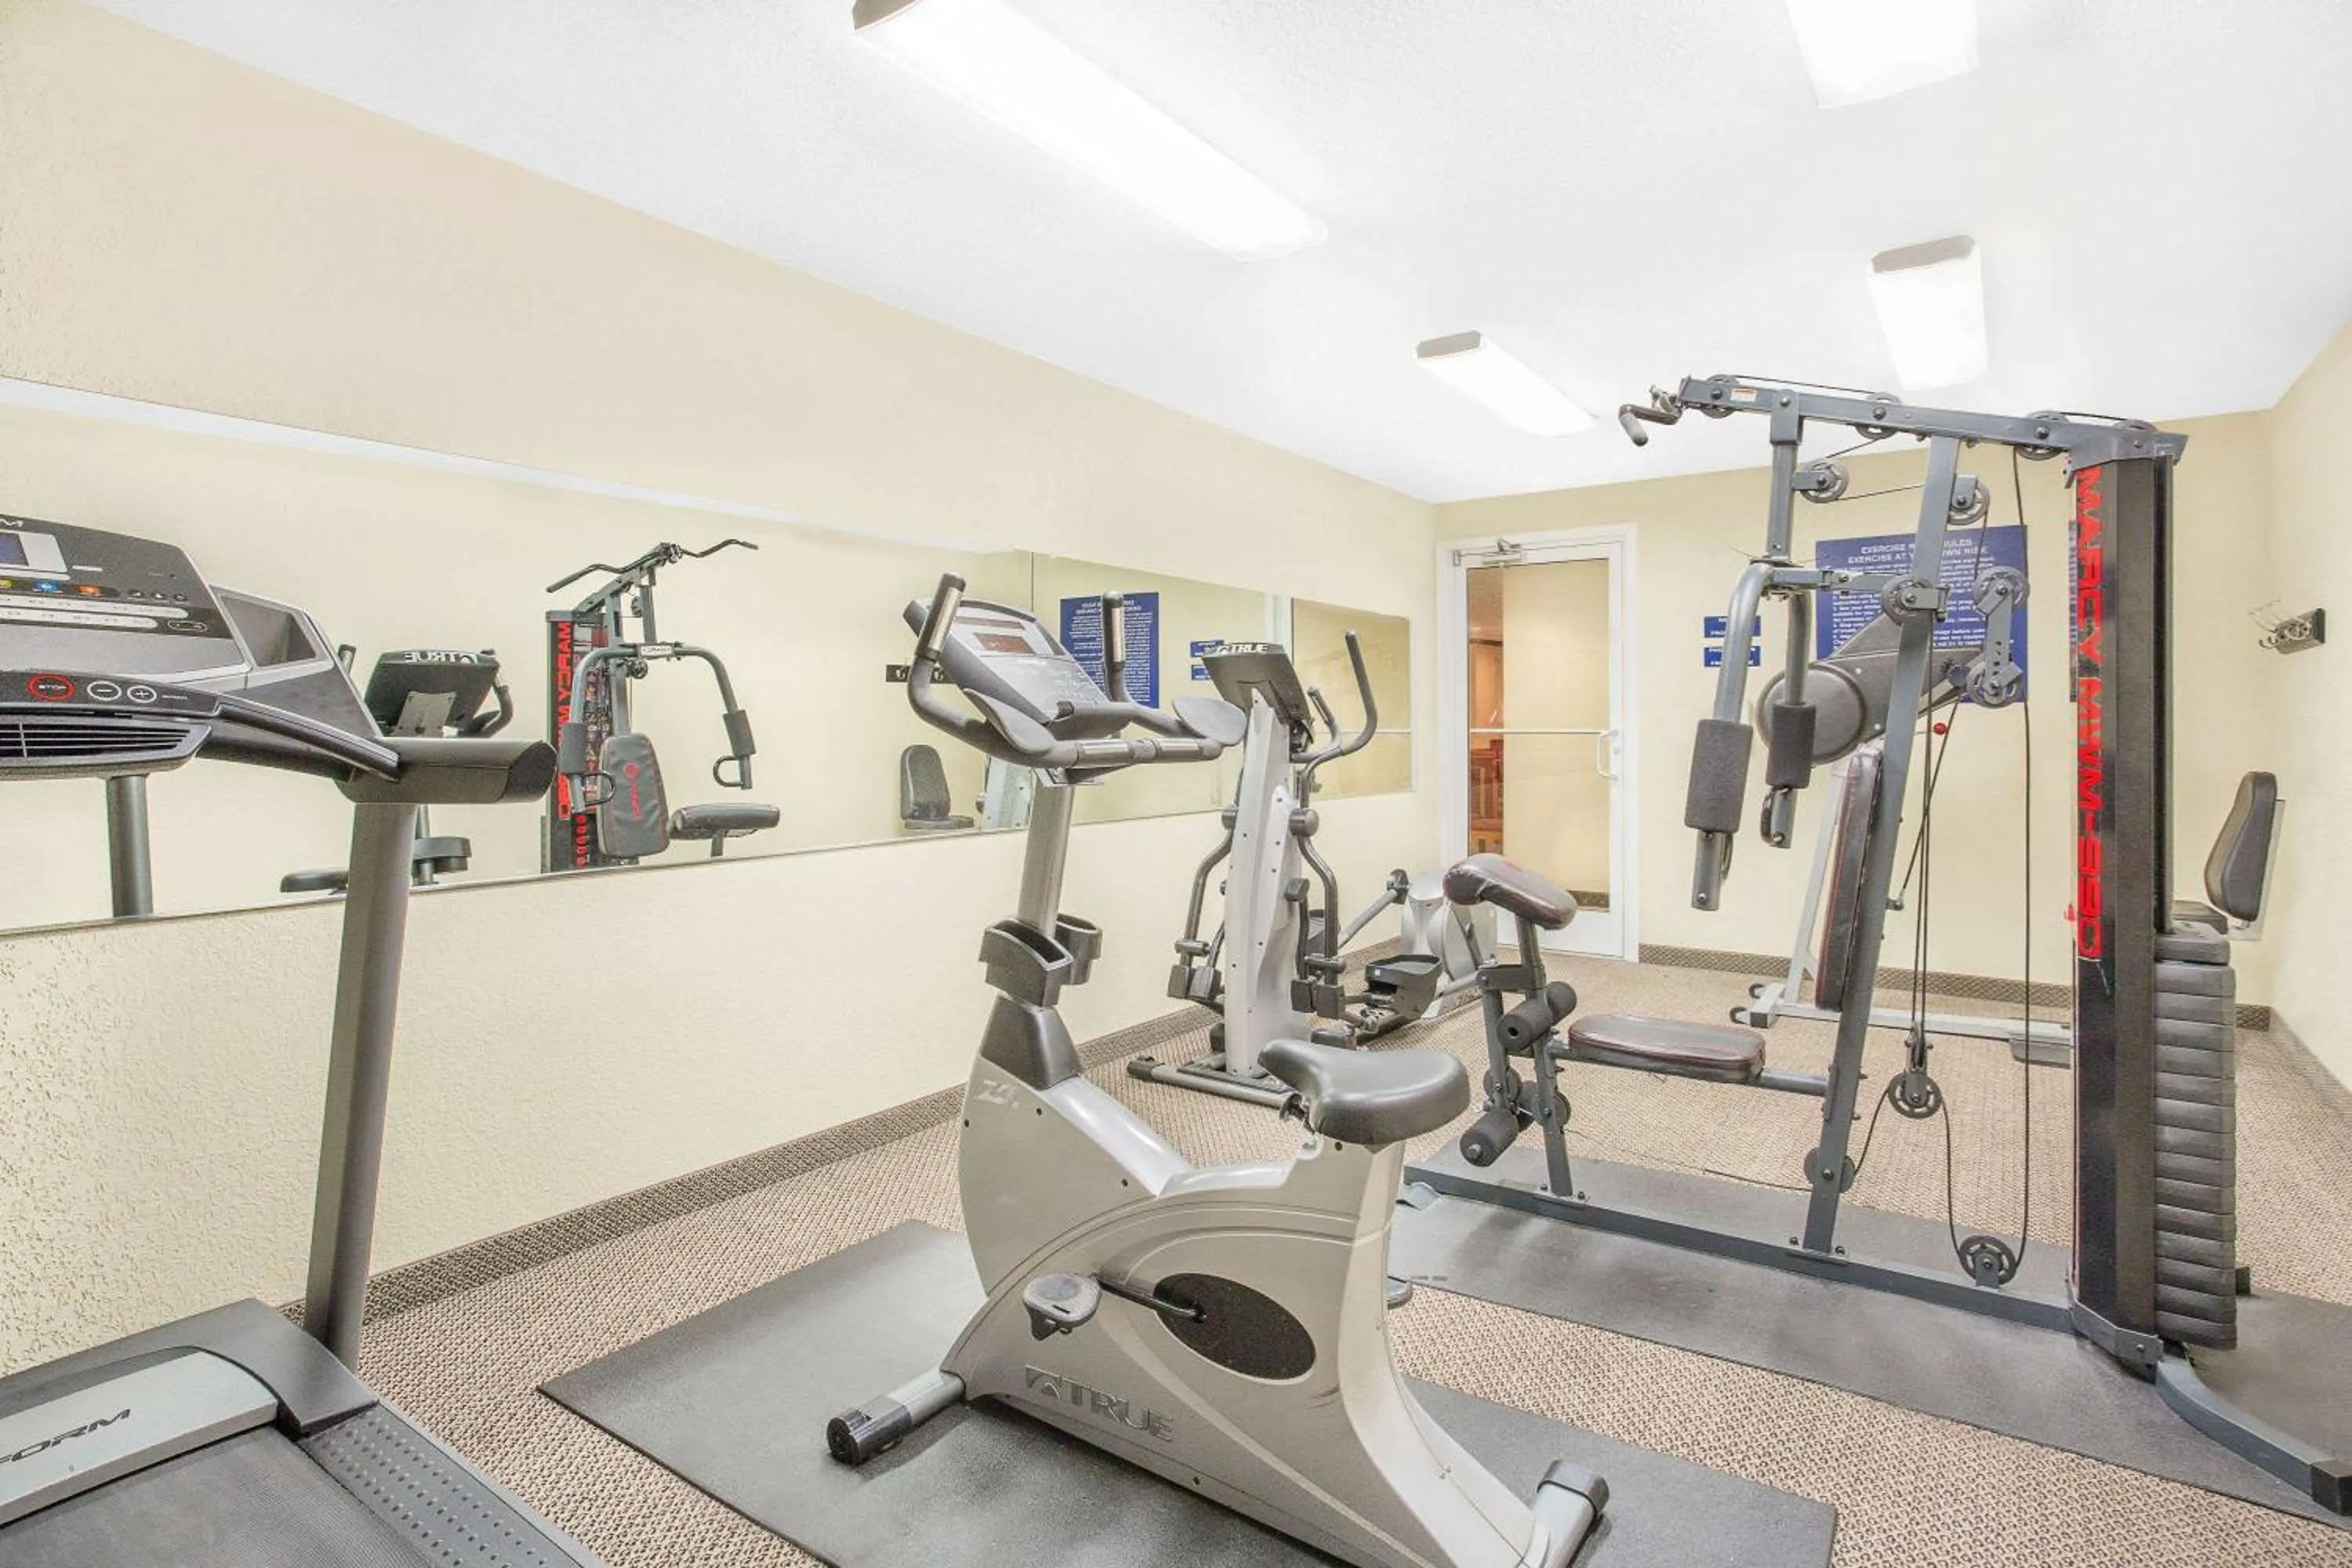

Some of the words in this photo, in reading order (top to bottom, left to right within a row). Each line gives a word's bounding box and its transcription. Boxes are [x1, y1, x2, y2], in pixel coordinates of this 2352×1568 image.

[1847, 553, 1892, 564] EXERCISE
[1894, 552, 1908, 561] AT
[2077, 466, 2103, 666] MARCY
[1230, 644, 1269, 653] TRUE
[1062, 1377, 1174, 1443] TRUE
